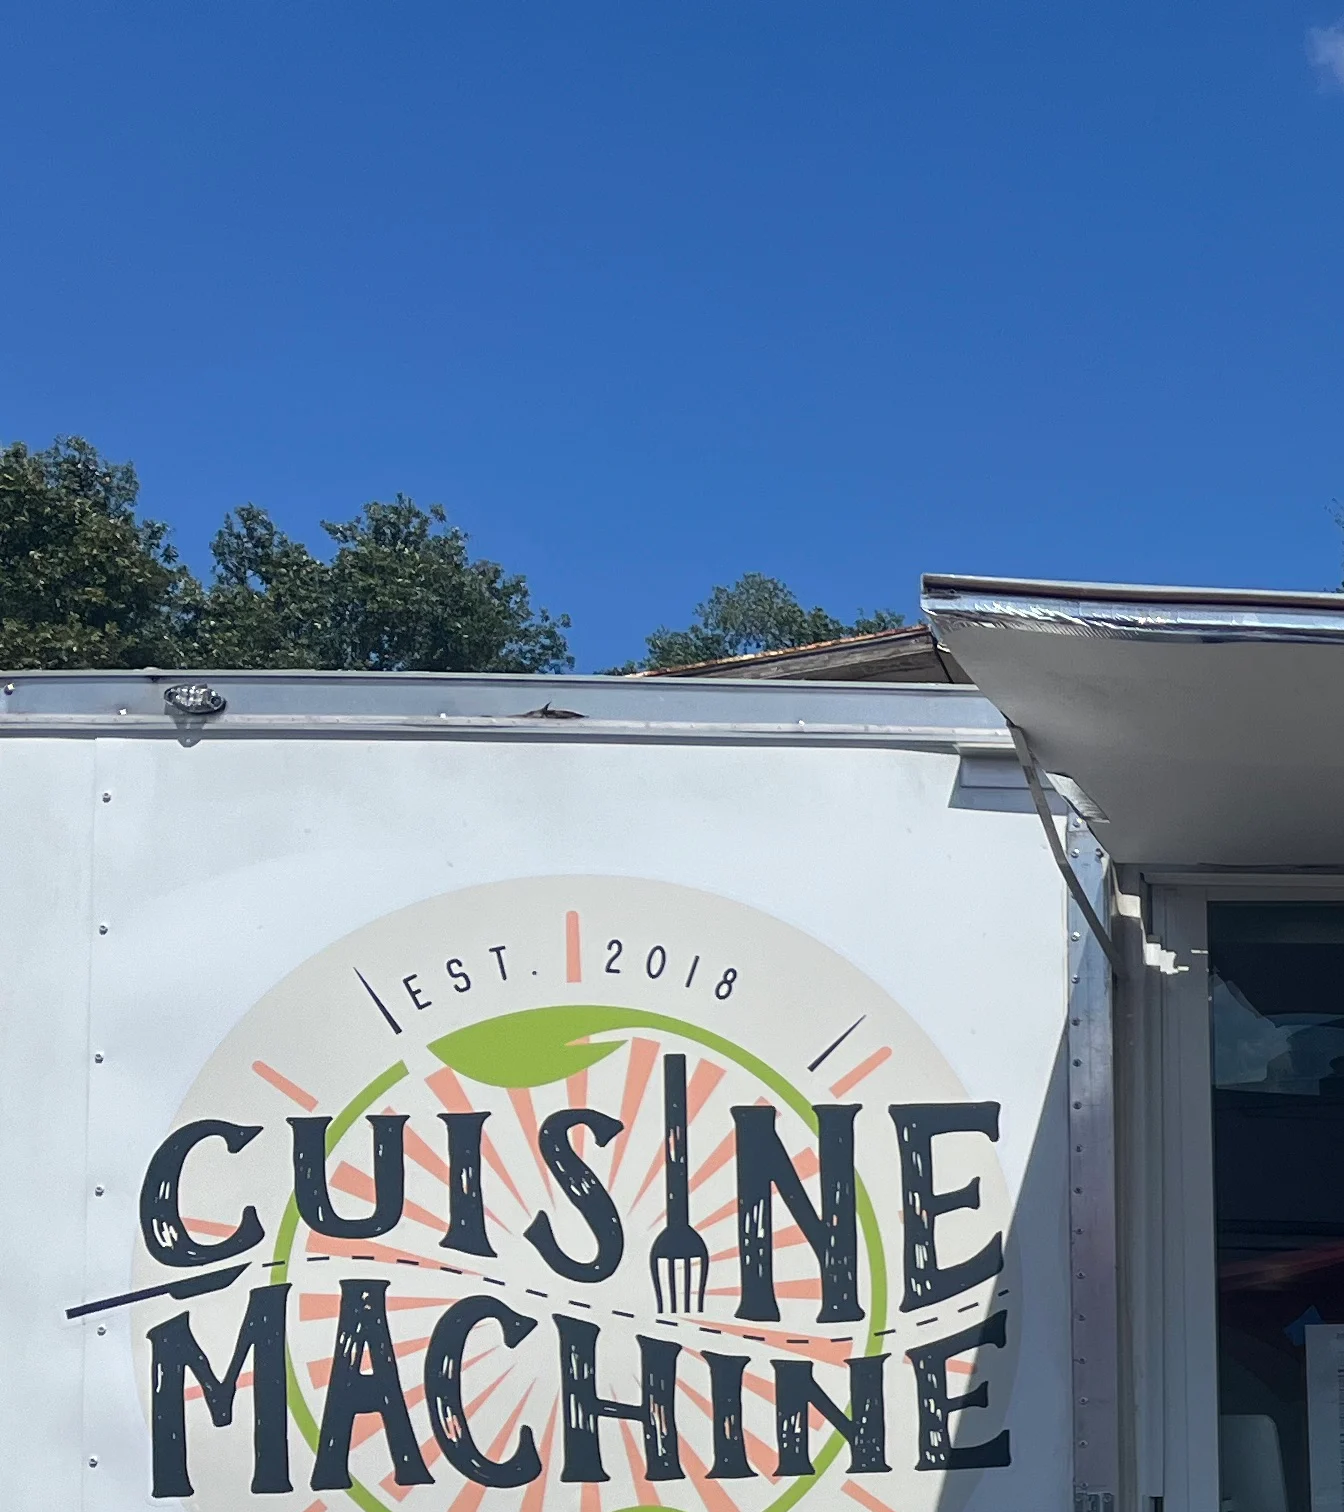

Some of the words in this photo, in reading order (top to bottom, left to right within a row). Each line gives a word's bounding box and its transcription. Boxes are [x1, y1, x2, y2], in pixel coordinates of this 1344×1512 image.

[403, 945, 539, 1012] EST.
[604, 938, 740, 1002] 2018
[138, 1054, 1005, 1324] CUISINE
[145, 1278, 1012, 1498] MACHINE
